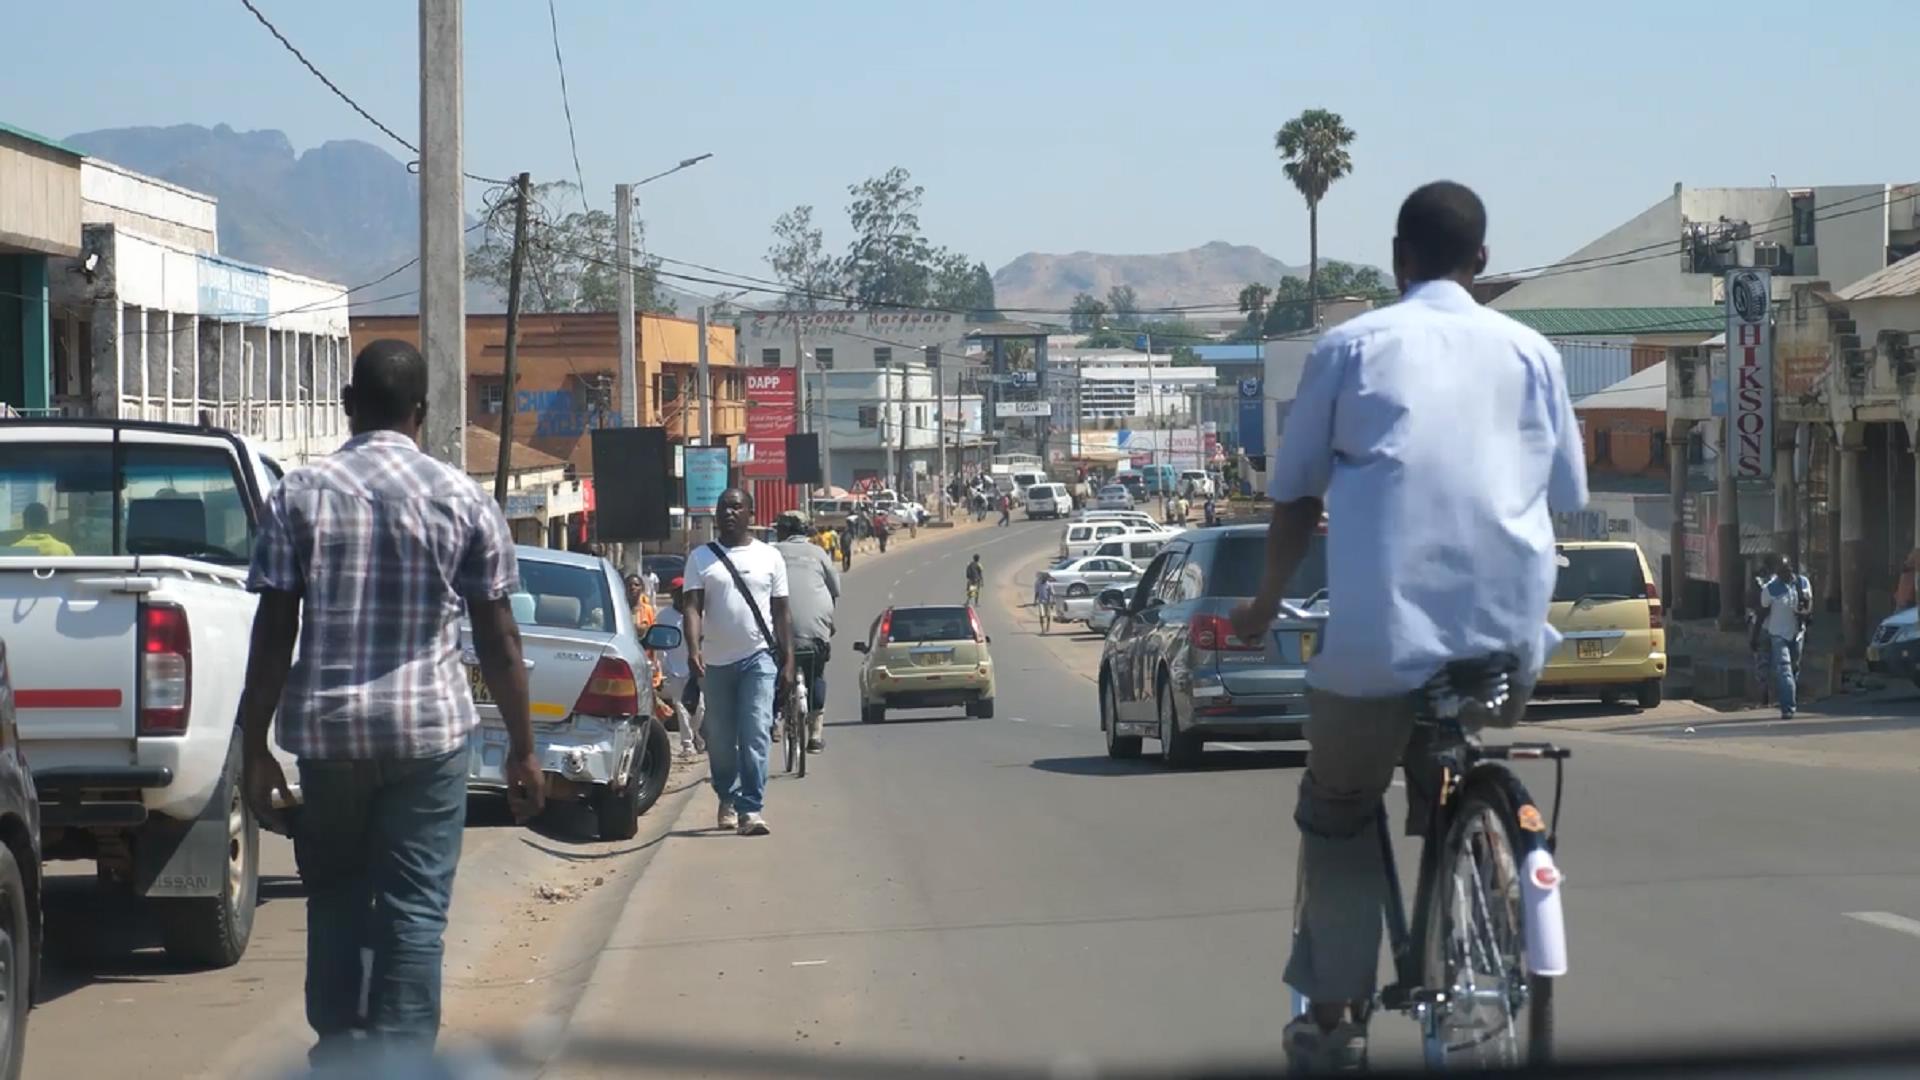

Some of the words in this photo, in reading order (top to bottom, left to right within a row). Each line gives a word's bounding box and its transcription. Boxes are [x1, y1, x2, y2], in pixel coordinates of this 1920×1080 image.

[748, 376, 781, 389] DAPP
[1737, 324, 1764, 478] HIKSONS
[156, 875, 209, 889] ISSAN
